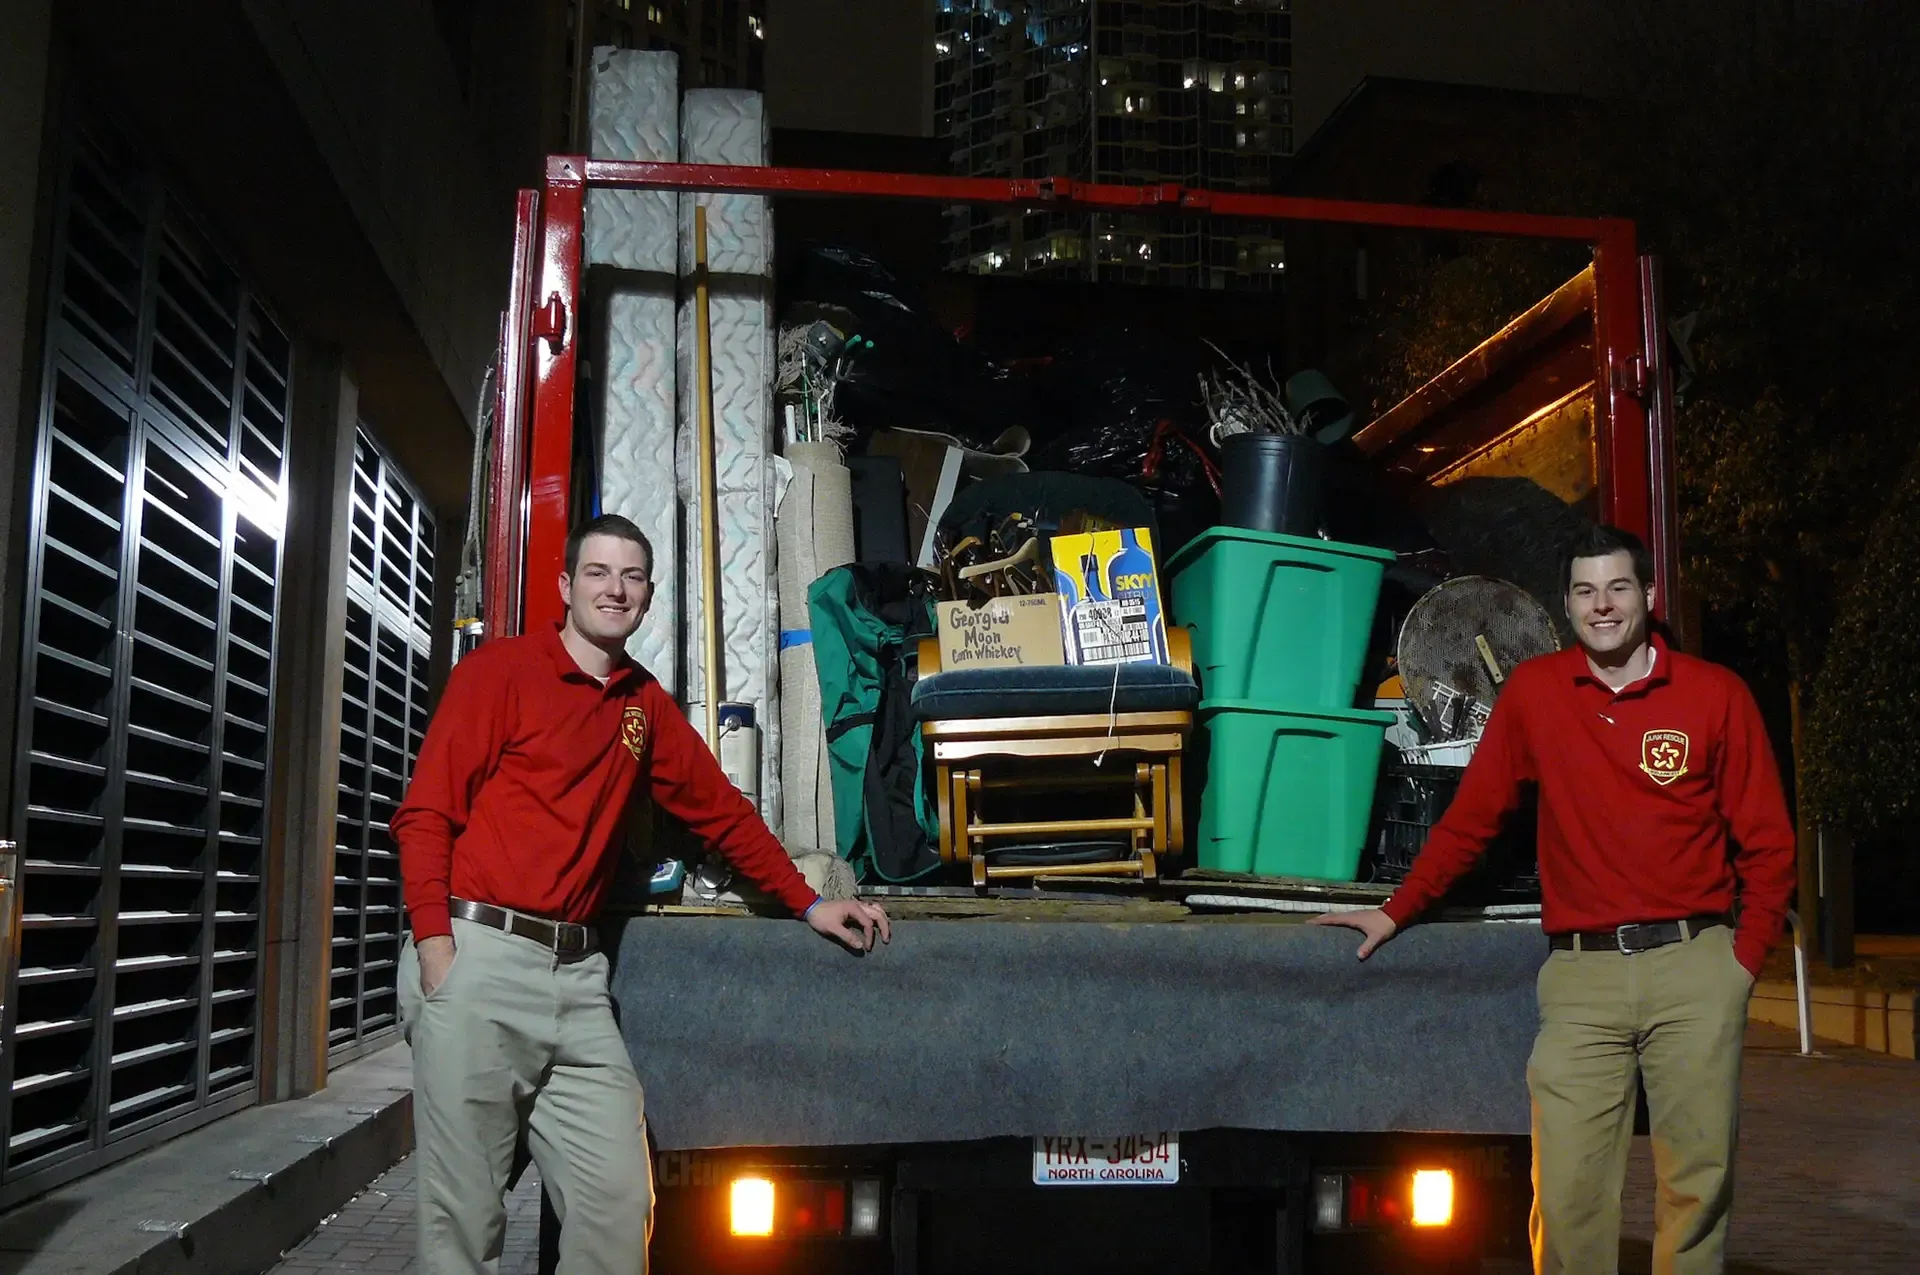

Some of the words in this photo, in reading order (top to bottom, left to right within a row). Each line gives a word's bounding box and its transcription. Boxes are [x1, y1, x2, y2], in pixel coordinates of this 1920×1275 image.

[1115, 573, 1153, 591] SKYY
[964, 626, 1001, 648] Moon
[1048, 1168, 1095, 1179] NORTH
[1099, 1168, 1165, 1180] CAROLINA
